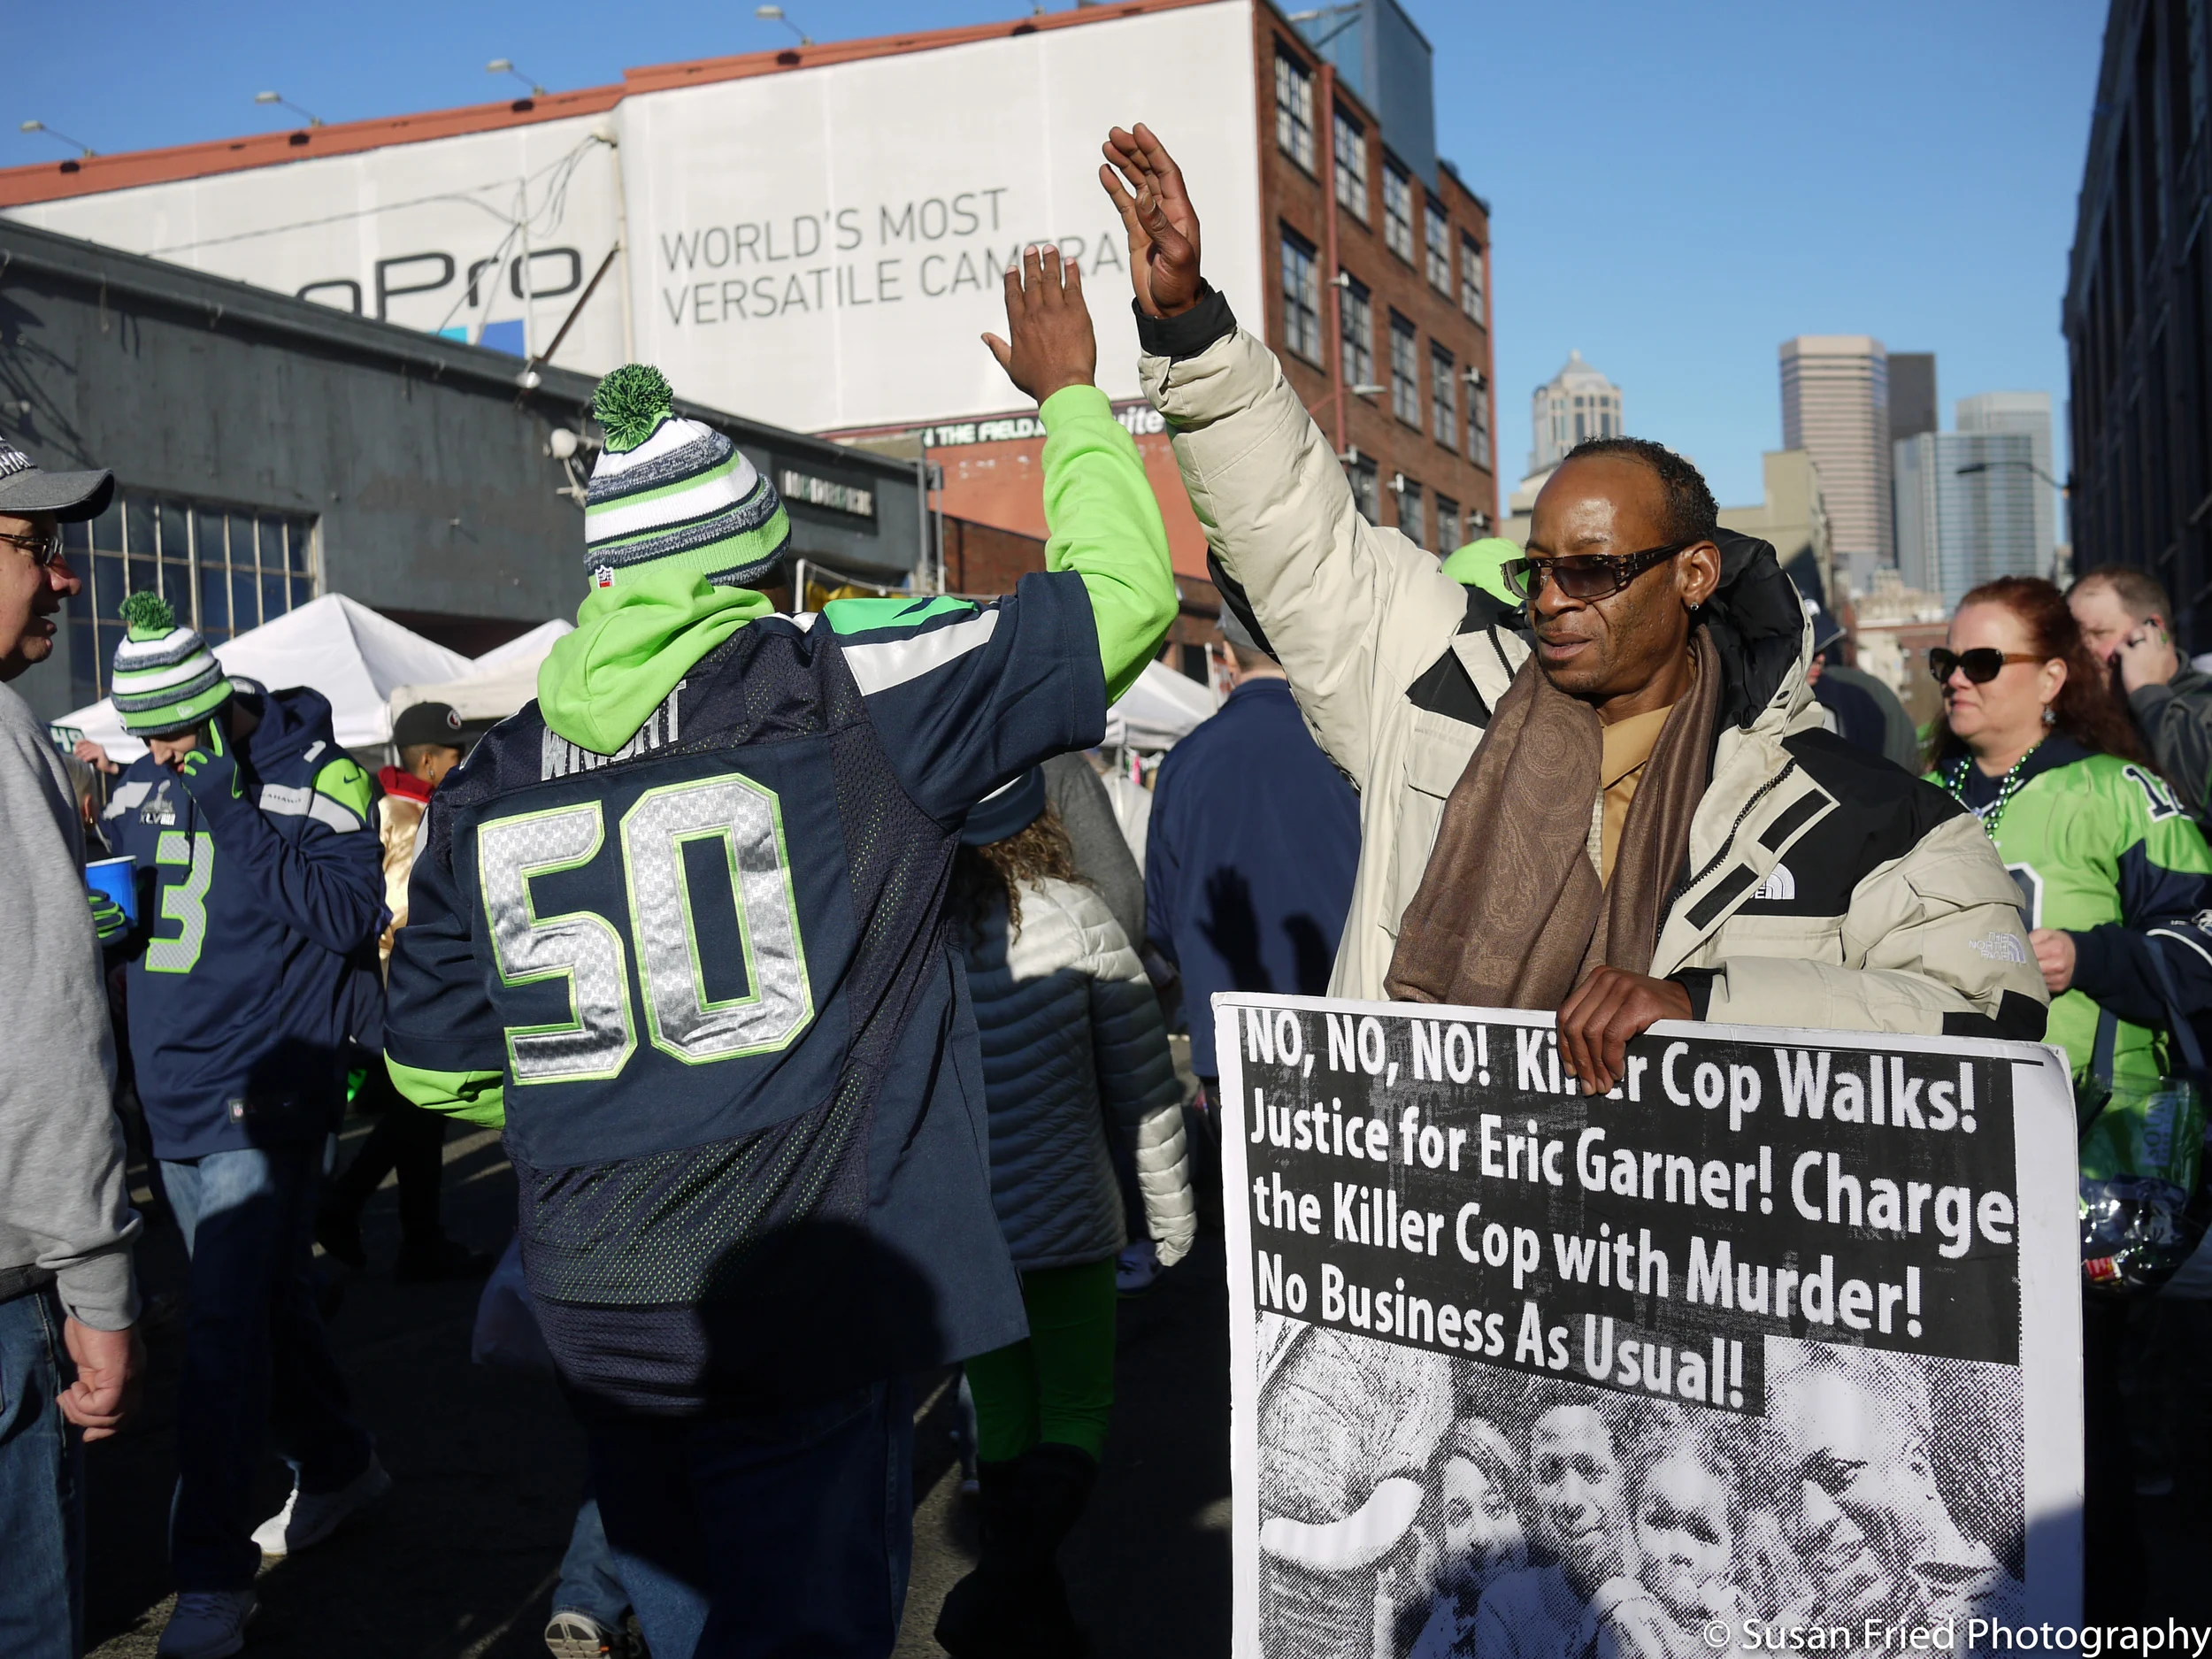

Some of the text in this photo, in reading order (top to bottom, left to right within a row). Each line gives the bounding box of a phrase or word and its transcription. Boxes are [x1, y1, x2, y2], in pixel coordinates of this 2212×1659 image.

[662, 187, 1008, 272] WORLD'S MOST
[663, 258, 902, 326] VERSATILE
[936, 424, 975, 445] THE
[144, 830, 215, 974] 3
[477, 772, 814, 1086] 50
[1969, 940, 2009, 954] NORTH
[1988, 932, 2009, 943] THE
[1981, 949, 2009, 962] FACE
[1246, 1008, 1977, 1133] NO, NO, NO! Kir Cop Walks!
[1250, 1087, 2014, 1259] Justice for Eric Garner! Charge
[1253, 1172, 1923, 1338] the Killer Cop with Murder!
[1258, 1249, 1744, 1409] No Business As Usual!
